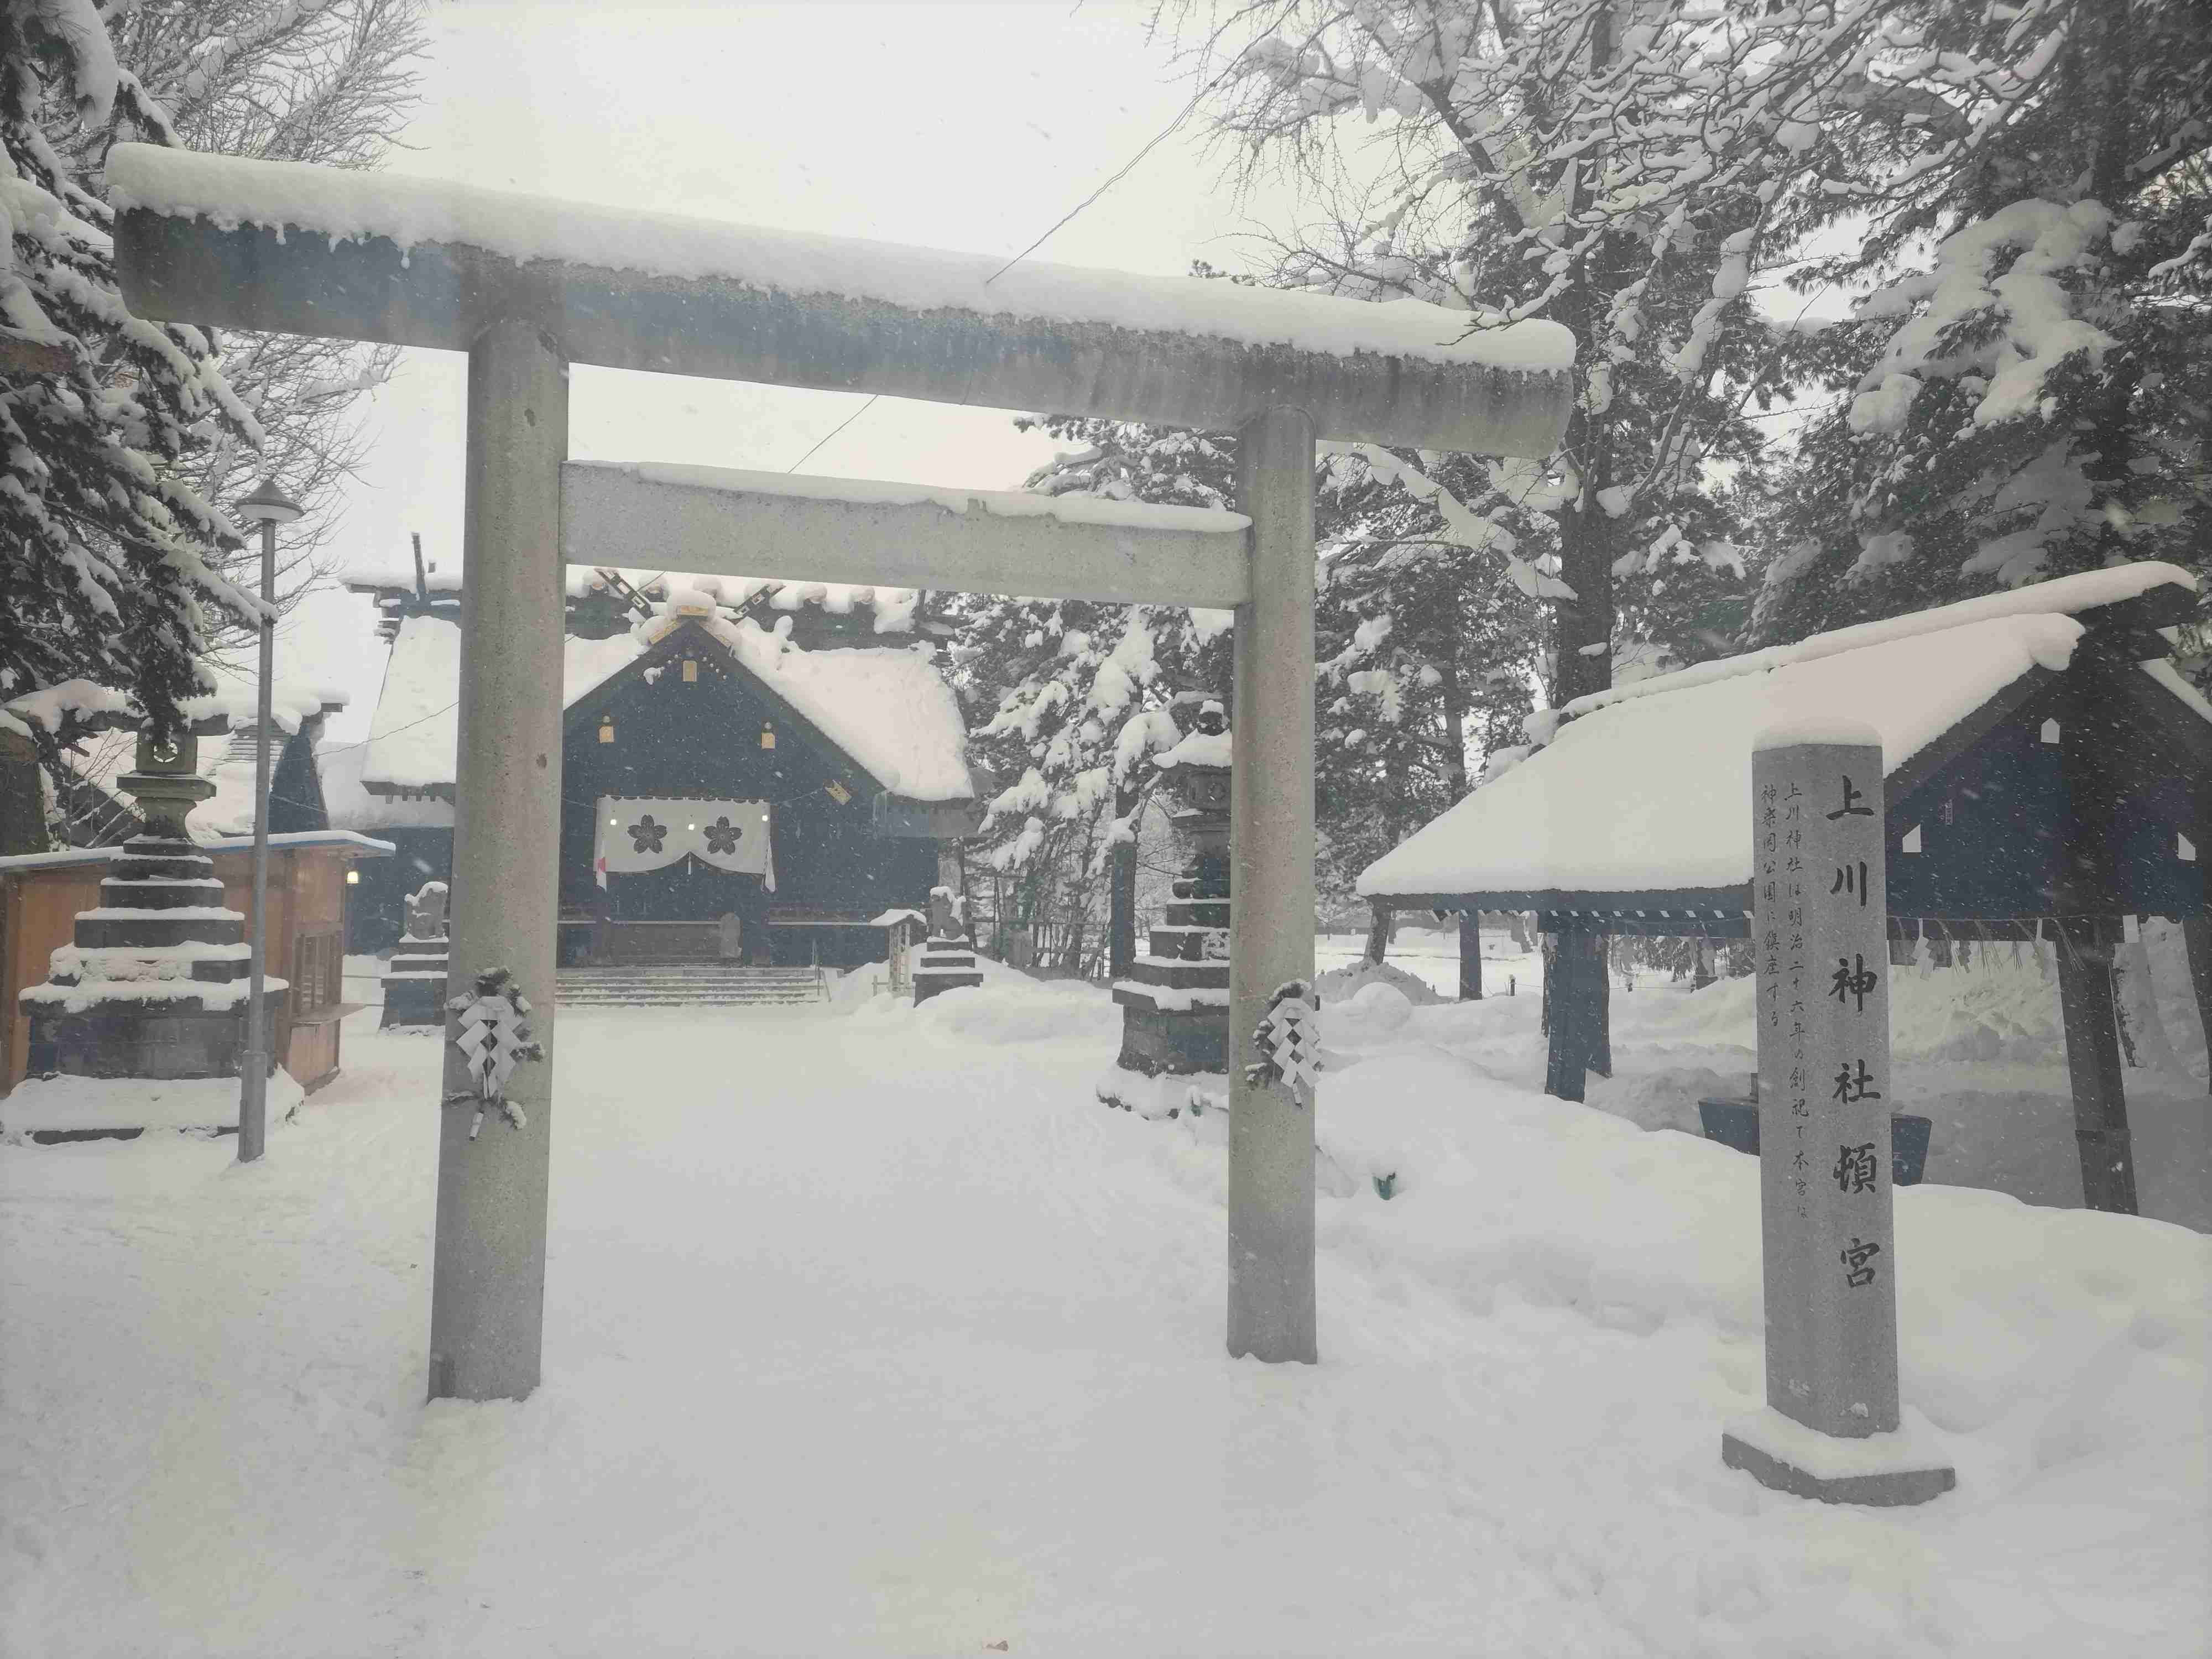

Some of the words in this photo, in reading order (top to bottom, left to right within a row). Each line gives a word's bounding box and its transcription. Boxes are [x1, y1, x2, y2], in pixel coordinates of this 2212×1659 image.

[1826, 775, 1880, 1288] 上川神社頓宮
